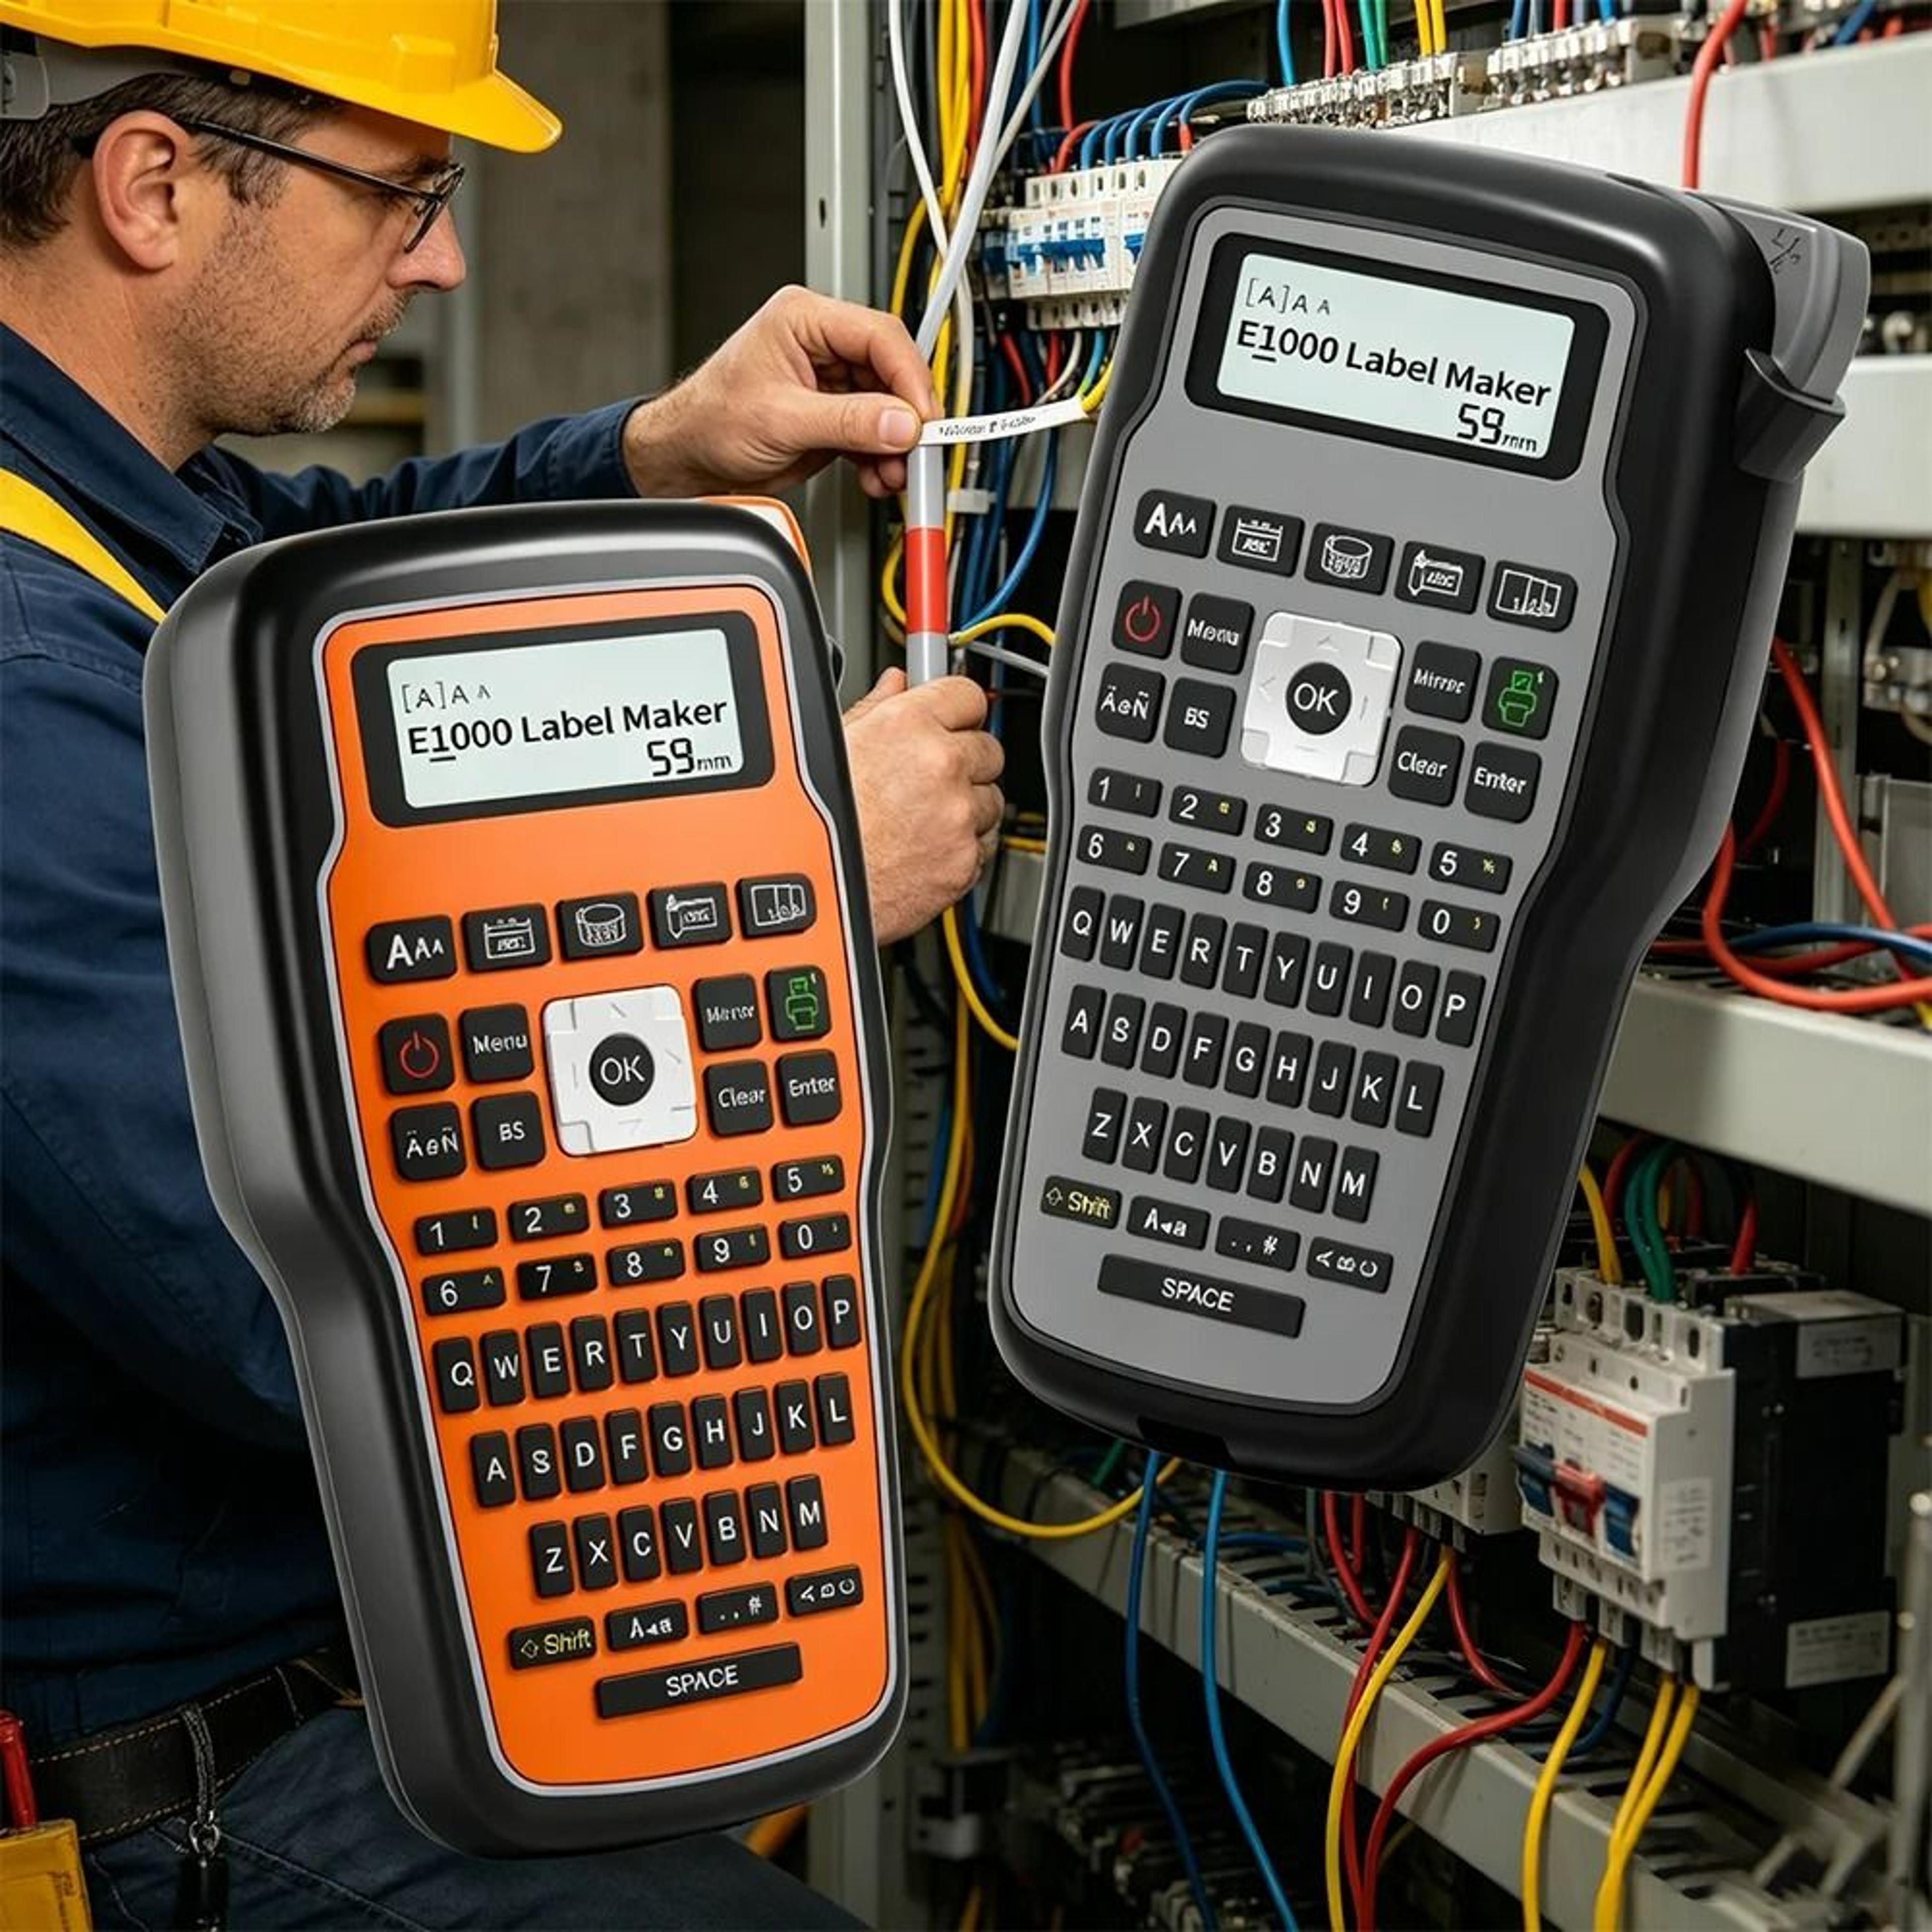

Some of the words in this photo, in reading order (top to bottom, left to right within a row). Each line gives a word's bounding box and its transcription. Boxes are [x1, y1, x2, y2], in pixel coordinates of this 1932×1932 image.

[1237, 319, 1339, 364] E1000
[1345, 342, 1438, 385] Label
[1444, 362, 1552, 407] Maker
[408, 718, 513, 756] E1000
[521, 706, 615, 743] Label
[622, 699, 727, 735] Maker
[1294, 683, 1338, 715] OK
[1398, 751, 1448, 777] Clear
[1474, 766, 1526, 794] Enter
[1099, 776, 1109, 801] 1
[1179, 793, 1198, 820] 2
[1265, 812, 1281, 838] 3
[1351, 832, 1368, 856] 4
[1439, 850, 1458, 876] 5
[1088, 833, 1104, 859] 6
[1173, 851, 1190, 877] 7
[1256, 870, 1273, 896] 8
[1343, 889, 1361, 915] 9
[1073, 910, 1092, 936] Q
[1111, 918, 1134, 944] W
[1151, 928, 1170, 953] E
[1191, 937, 1210, 963] R
[1236, 946, 1254, 972] T
[1277, 955, 1295, 981] Y
[1317, 964, 1337, 990] U
[1364, 976, 1373, 1000] I
[1401, 984, 1422, 1010] O
[1445, 994, 1466, 1017] P
[473, 1035, 527, 1054] Menu
[600, 1055, 645, 1085] OK
[1070, 1008, 1088, 1034] A
[1112, 1017, 1130, 1042] S
[1151, 1026, 1171, 1052] D
[1193, 1037, 1212, 1060] F
[1236, 1046, 1255, 1072] G
[1276, 1056, 1297, 1081] H
[1322, 1067, 1338, 1090] J
[1361, 1074, 1383, 1101] K
[1407, 1085, 1422, 1110] L
[718, 1087, 766, 1108] Clear
[789, 1078, 835, 1097] Enter
[500, 1121, 525, 1142] BS
[1092, 1112, 1112, 1138] Z
[1132, 1121, 1152, 1148] X
[1175, 1132, 1193, 1156] C
[1220, 1141, 1237, 1166] V
[1258, 1151, 1276, 1176] B
[1300, 1160, 1322, 1187] N
[1342, 1170, 1365, 1197] M
[430, 1222, 443, 1246] 1
[525, 1207, 542, 1233] 2
[614, 1193, 631, 1218] 3
[702, 1180, 718, 1204] 4
[787, 1167, 802, 1193] 5
[440, 1280, 458, 1306] 6
[536, 1265, 551, 1292] 7
[627, 1251, 643, 1277] 8
[713, 1238, 730, 1263] 9
[797, 1224, 813, 1250] 0
[1161, 1277, 1234, 1312] SPACE
[451, 1361, 474, 1386] Q
[494, 1354, 518, 1379] W
[543, 1347, 560, 1373] E
[585, 1340, 605, 1366] R
[629, 1333, 646, 1358] T
[671, 1326, 687, 1350] Y
[713, 1320, 731, 1344] U
[760, 1313, 768, 1337] I
[794, 1306, 813, 1330] O
[834, 1299, 850, 1324] P
[487, 1457, 507, 1482] A
[532, 1450, 550, 1474] S
[576, 1442, 595, 1467] D
[621, 1434, 636, 1460] F
[663, 1426, 683, 1451] G
[706, 1419, 725, 1443] H
[752, 1412, 764, 1435] J
[788, 1403, 807, 1429] K
[830, 1398, 847, 1422] L
[546, 1547, 564, 1573] Z
[589, 1540, 608, 1565] X
[633, 1532, 651, 1556] C
[675, 1522, 693, 1548] V
[718, 1516, 736, 1541] B
[759, 1508, 779, 1533] N
[799, 1500, 820, 1526] M
[666, 1664, 739, 1697] SPACE
